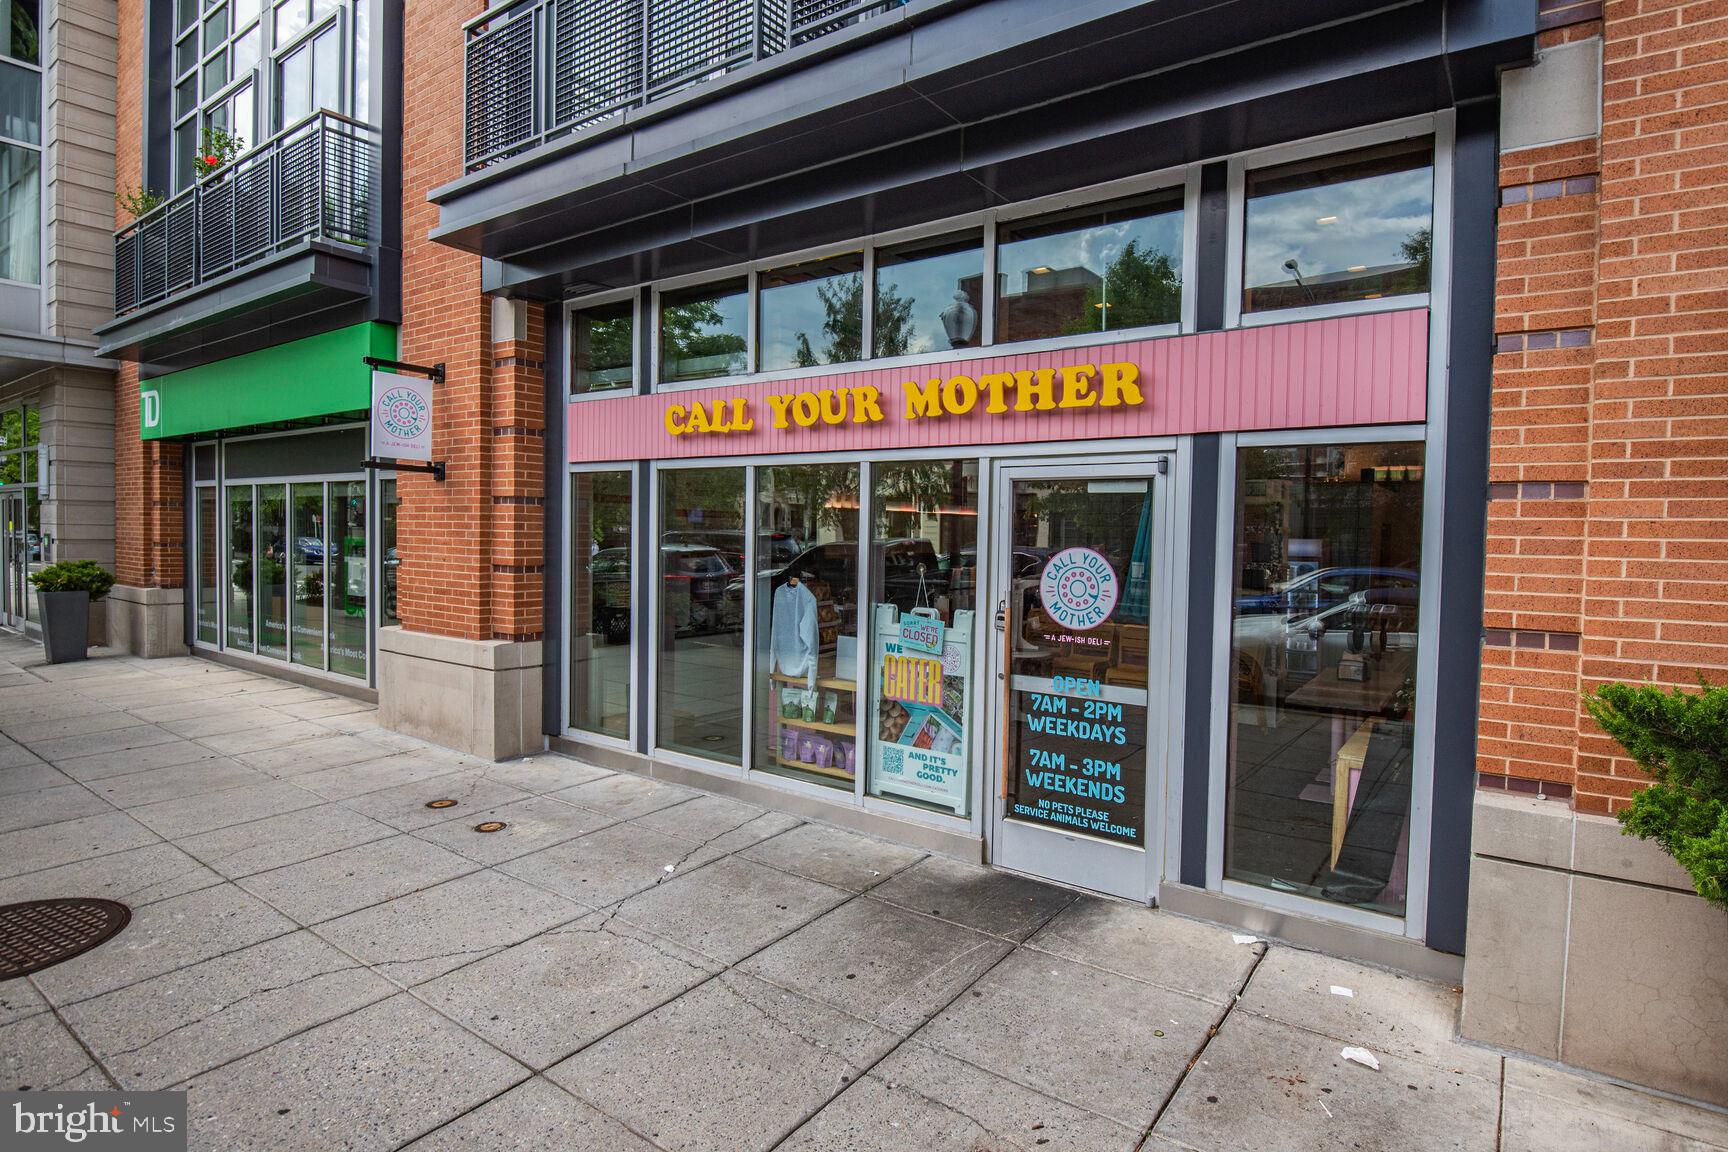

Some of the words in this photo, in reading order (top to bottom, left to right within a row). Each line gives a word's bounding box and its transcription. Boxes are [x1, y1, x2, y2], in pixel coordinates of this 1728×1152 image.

[141, 389, 160, 428] TD
[382, 389, 403, 407] CALL
[406, 391, 426, 411] YOUR
[664, 398, 753, 435] CALL
[768, 385, 885, 429] YOUR
[903, 361, 1145, 420] MOTHER
[384, 420, 422, 437] MOTHER
[1046, 552, 1077, 581] CALL
[1082, 552, 1112, 584] YOUR
[1049, 601, 1105, 627] MOTHER
[902, 628, 939, 645] CLOSED
[920, 624, 939, 634] WE'RE
[1057, 634, 1086, 645] JEW-ISH
[1087, 637, 1103, 646] DELI
[885, 643, 903, 654] WE
[883, 654, 943, 706] CATER
[1053, 675, 1100, 697] OPEN
[1031, 693, 1067, 715] 7AM
[1084, 701, 1122, 722] 2PM
[1027, 713, 1127, 745] WEEKDAYS
[908, 751, 927, 761] AND
[929, 755, 946, 765] IT'S
[1029, 748, 1066, 771] 7AM
[1082, 758, 1121, 781] 3PM
[916, 770, 946, 784] GOOD.
[922, 763, 958, 777] PRETTY
[1025, 768, 1126, 804] WEEKENDS
[1014, 803, 1049, 819] SERVICE
[1050, 811, 1088, 828] ANIMALS
[1090, 820, 1137, 838] WELCOME
[1038, 799, 1050, 809] NO
[1052, 801, 1074, 814] PETS
[1075, 807, 1110, 821] PLEASE
